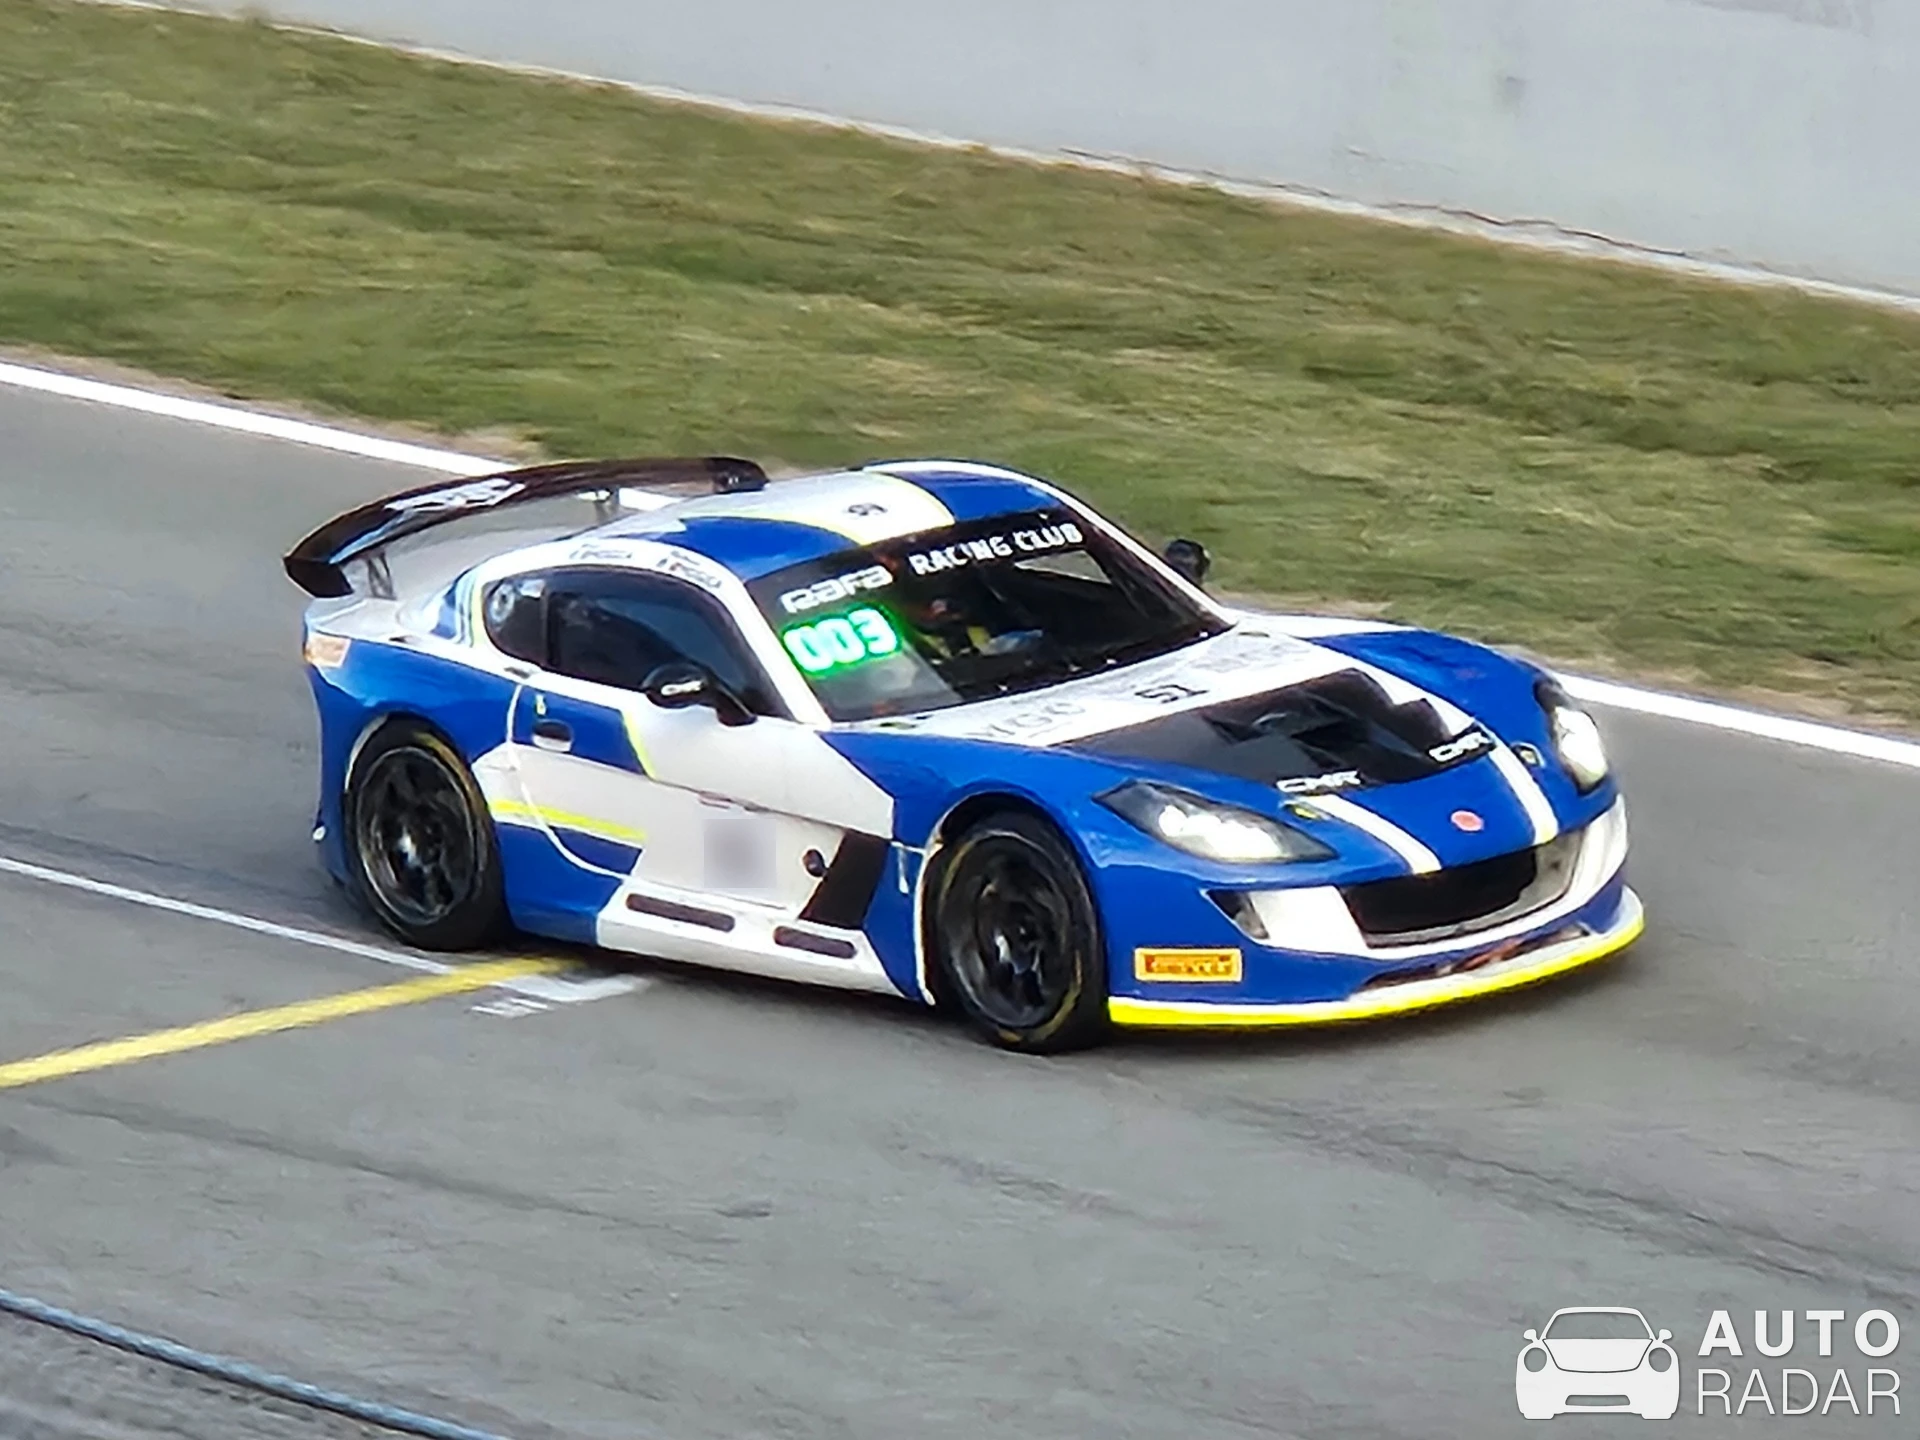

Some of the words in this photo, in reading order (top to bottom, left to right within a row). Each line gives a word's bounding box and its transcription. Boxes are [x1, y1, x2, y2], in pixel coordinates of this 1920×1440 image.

[908, 537, 1013, 575] RACING
[1012, 522, 1084, 551] CLUB
[783, 606, 898, 673] 003
